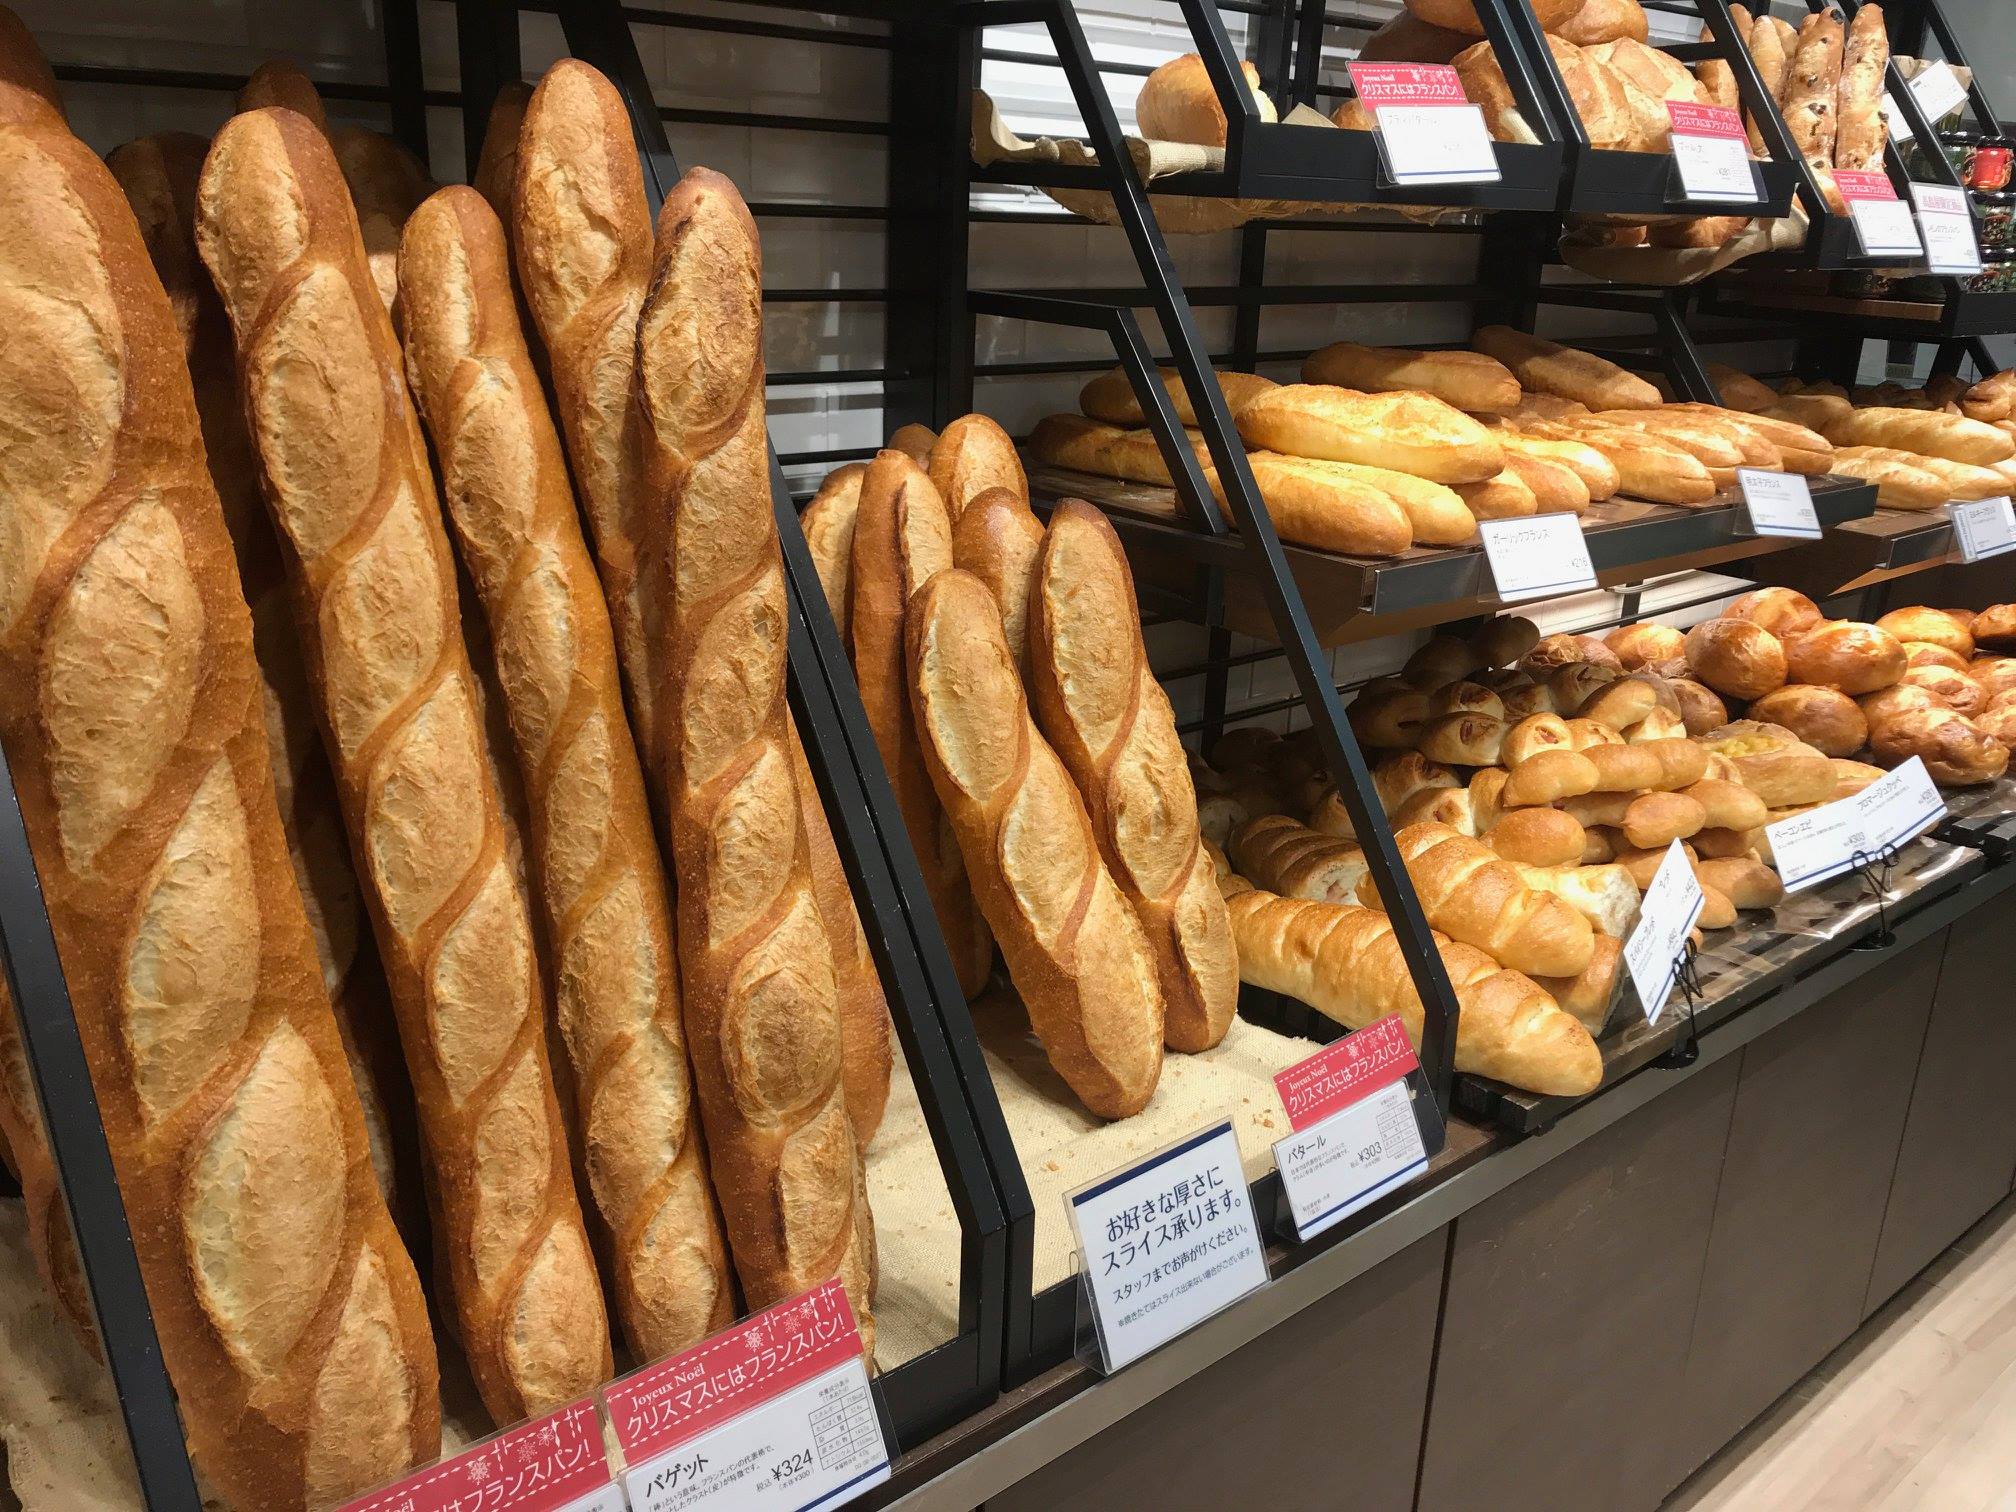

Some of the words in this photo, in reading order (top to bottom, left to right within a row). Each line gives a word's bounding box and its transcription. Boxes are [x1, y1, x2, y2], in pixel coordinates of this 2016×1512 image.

[1289, 1038, 1406, 1112] クリスマスにはフランスパン!
[1357, 1141, 1383, 1163] ¥303
[1101, 1188, 1242, 1277] スライス承ります。
[1106, 1165, 1225, 1243] お好きな厚さに
[1112, 1223, 1249, 1305] スタッフまでお声がけください。
[627, 1312, 846, 1440] クリスマスにはフランスパン!
[631, 1381, 675, 1413] Joyeux
[674, 1363, 706, 1389] Noël
[646, 1453, 709, 1499] バゲット
[771, 1448, 814, 1482] ¥324
